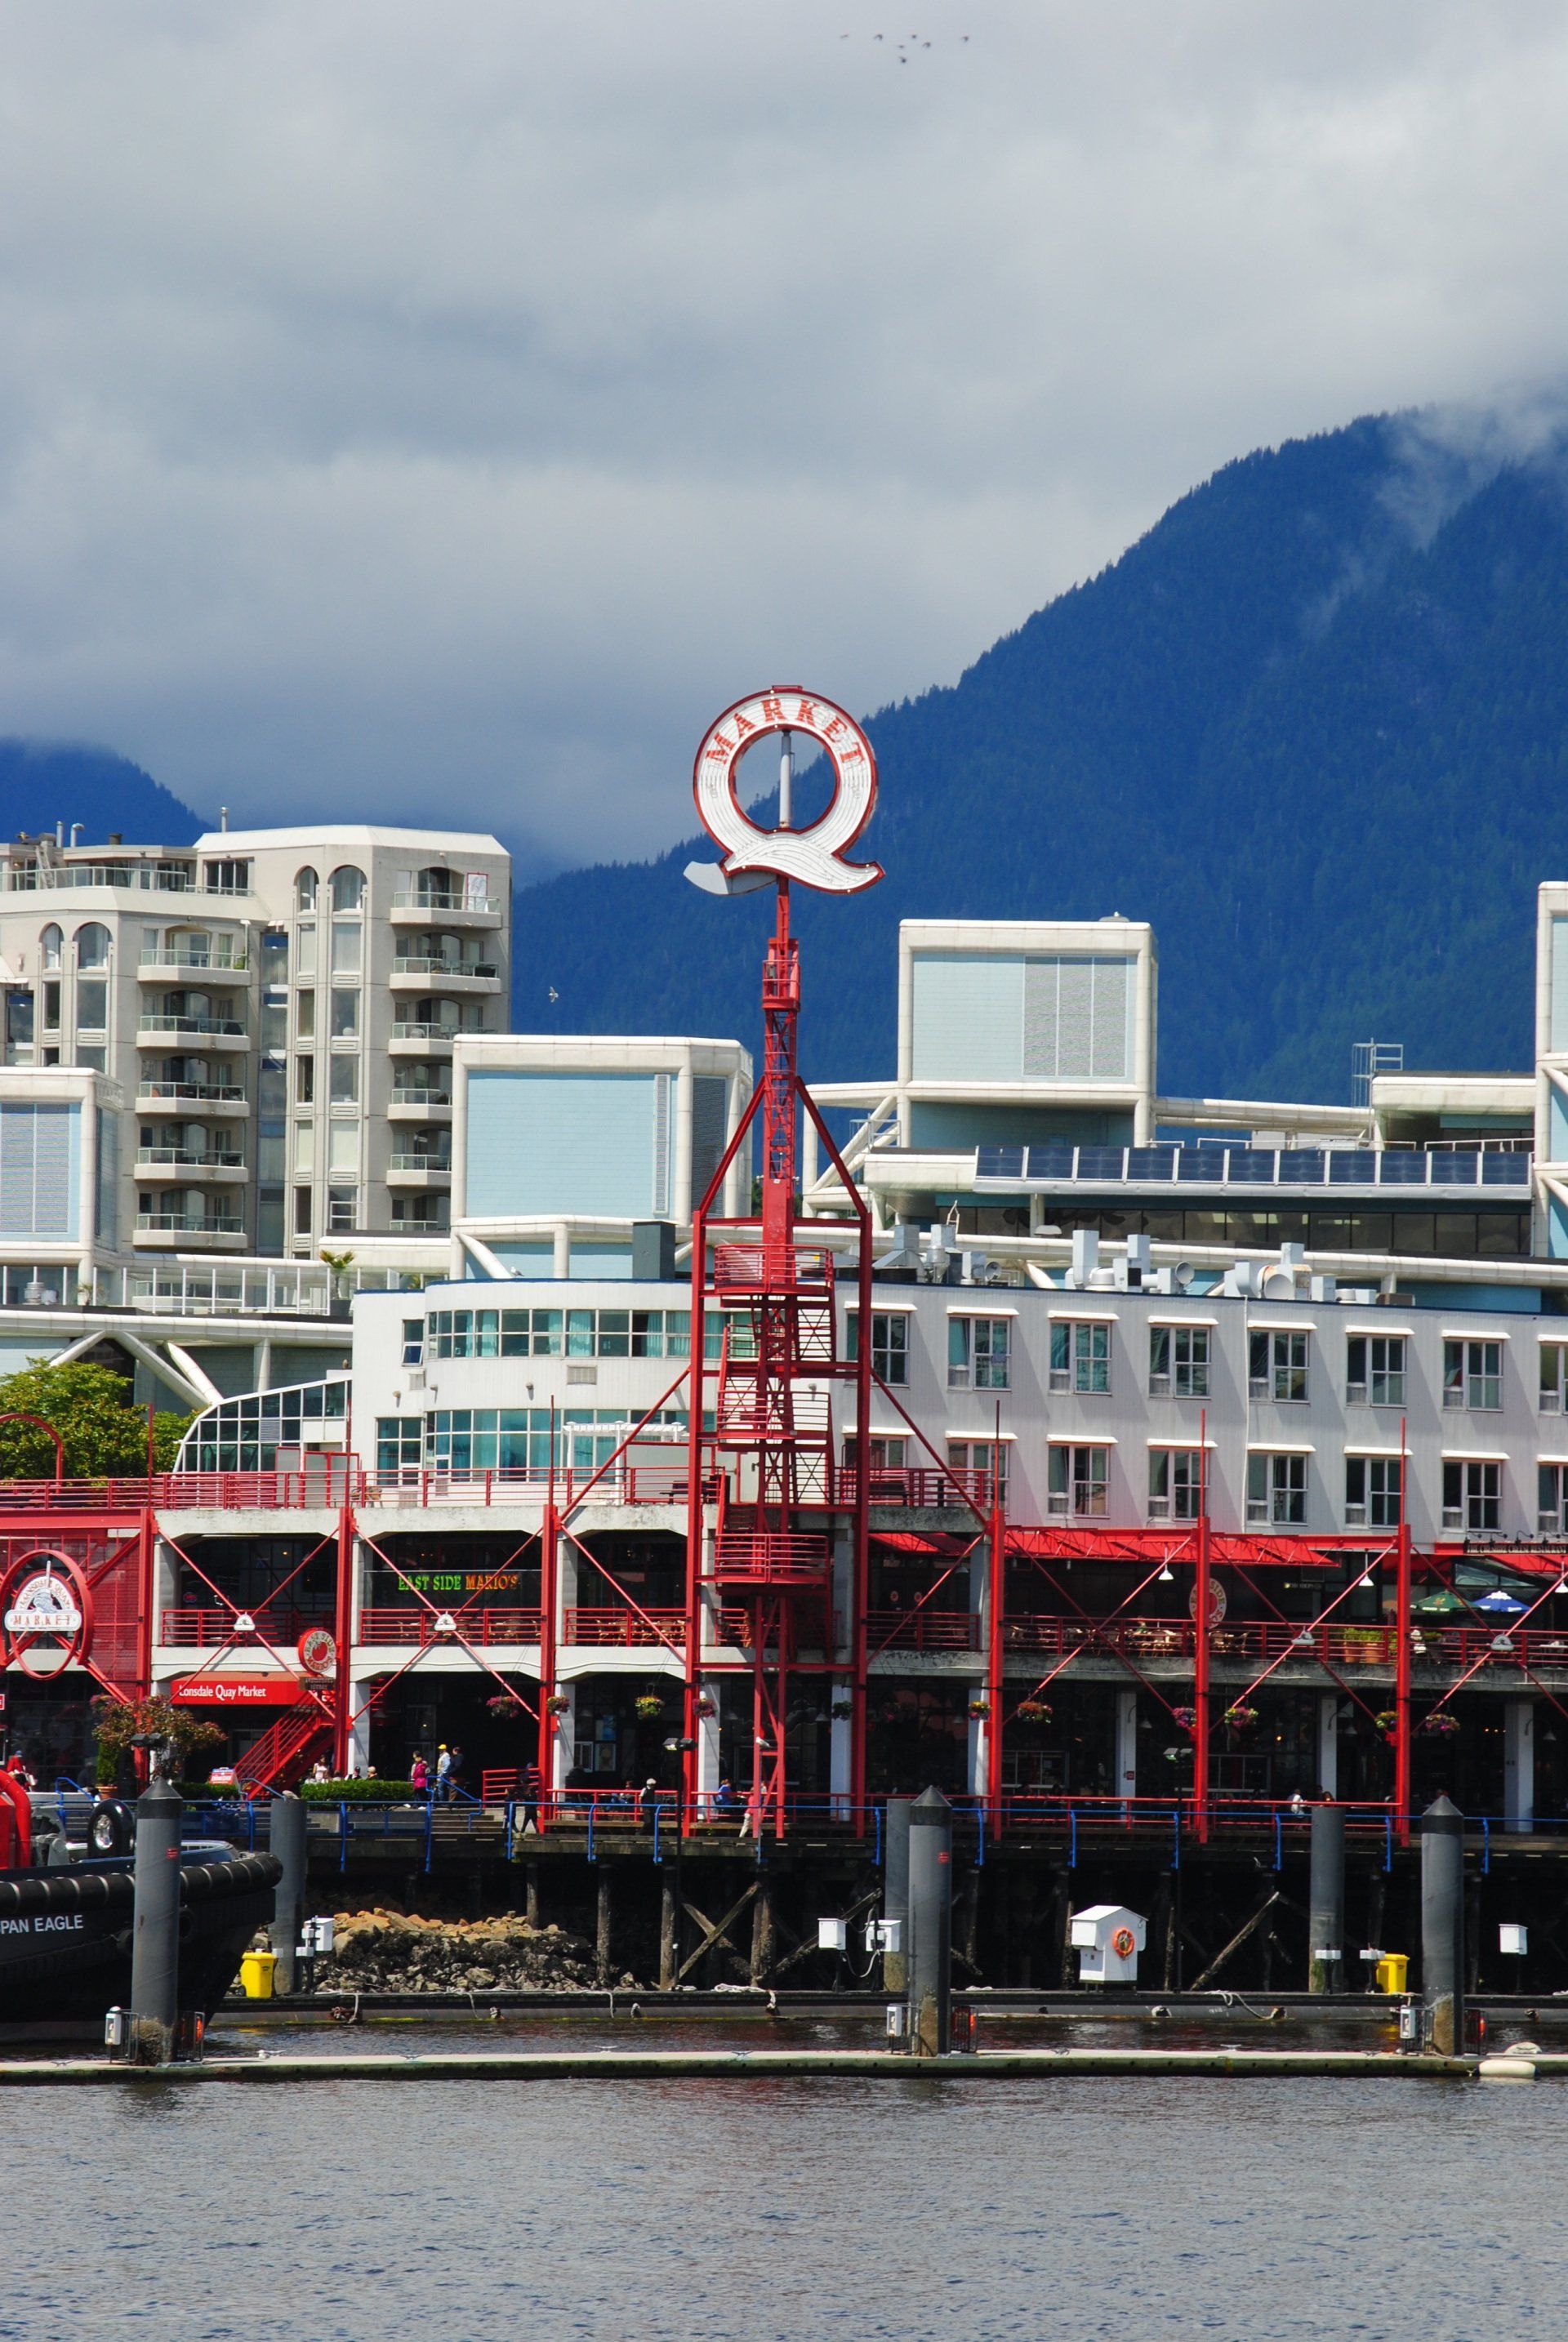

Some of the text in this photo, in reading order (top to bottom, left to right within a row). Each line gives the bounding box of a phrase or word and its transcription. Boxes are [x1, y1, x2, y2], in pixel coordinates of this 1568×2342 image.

[705, 697, 866, 766] MARKET
[398, 1574, 519, 1591] EAST SIDE MARIO'S
[13, 1614, 72, 1627] MARKET
[179, 1684, 266, 1701] Lonsdale Quay Market
[0, 1914, 84, 1935] PAN EAGLE
